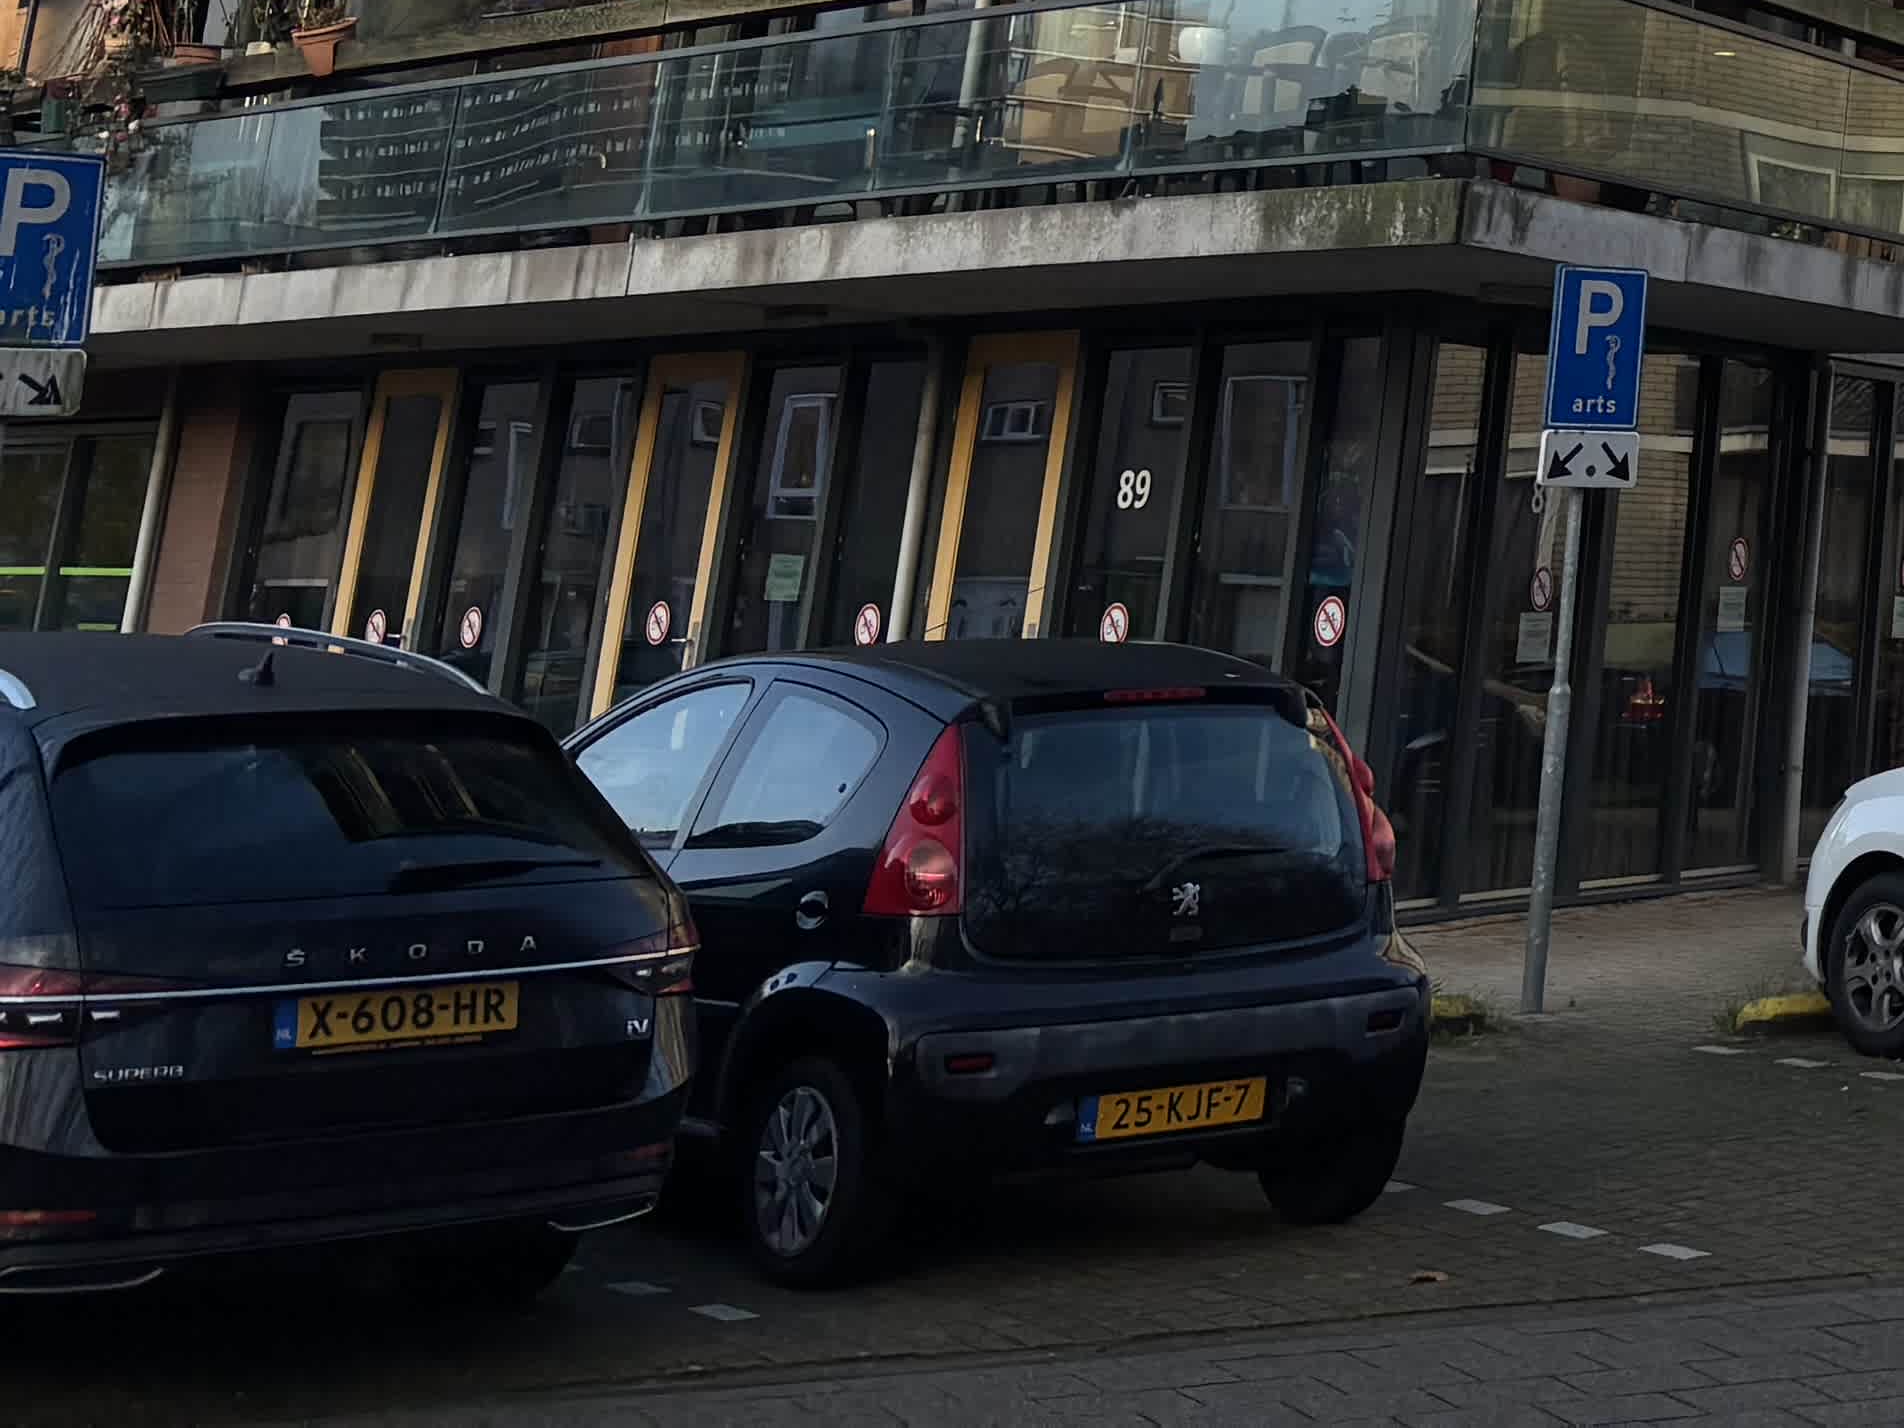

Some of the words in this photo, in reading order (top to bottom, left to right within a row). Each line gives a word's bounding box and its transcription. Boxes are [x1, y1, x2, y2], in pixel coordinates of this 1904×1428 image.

[0, 167, 72, 258] P
[0, 304, 57, 329] rts
[1575, 279, 1624, 355] P
[1571, 395, 1617, 414] arts
[1116, 469, 1152, 510] 89
[308, 987, 506, 1040] X-608-HR
[1111, 1082, 1251, 1131] 25-KJF-7
